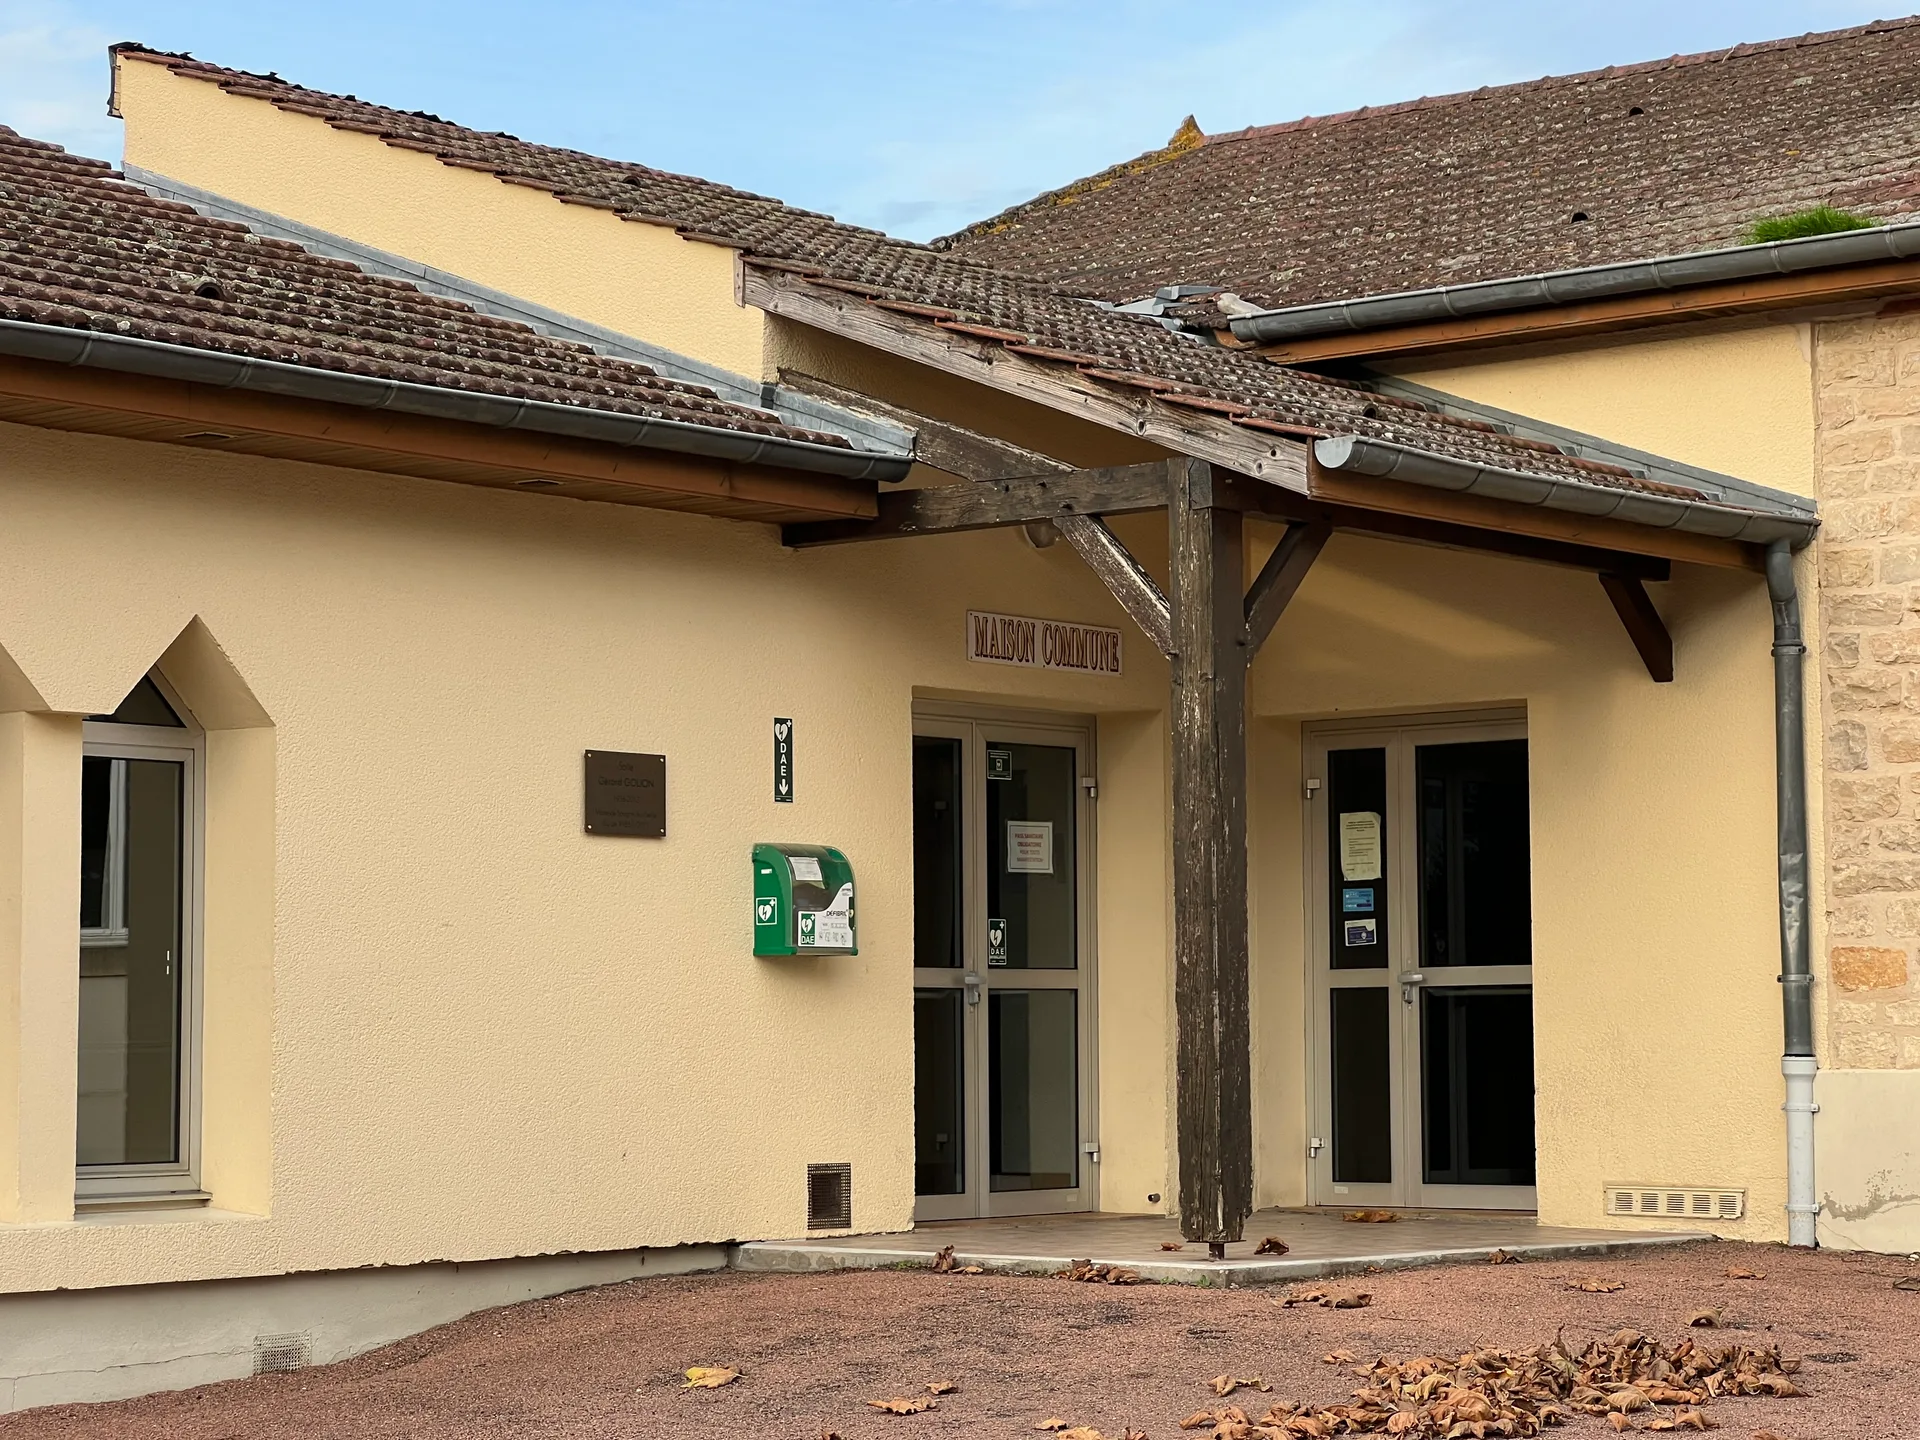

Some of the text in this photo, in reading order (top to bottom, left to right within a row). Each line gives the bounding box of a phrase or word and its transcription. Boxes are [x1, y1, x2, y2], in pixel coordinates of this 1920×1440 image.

[974, 616, 1119, 672] MAISON COMMUNE
[800, 935, 815, 944] DAE
